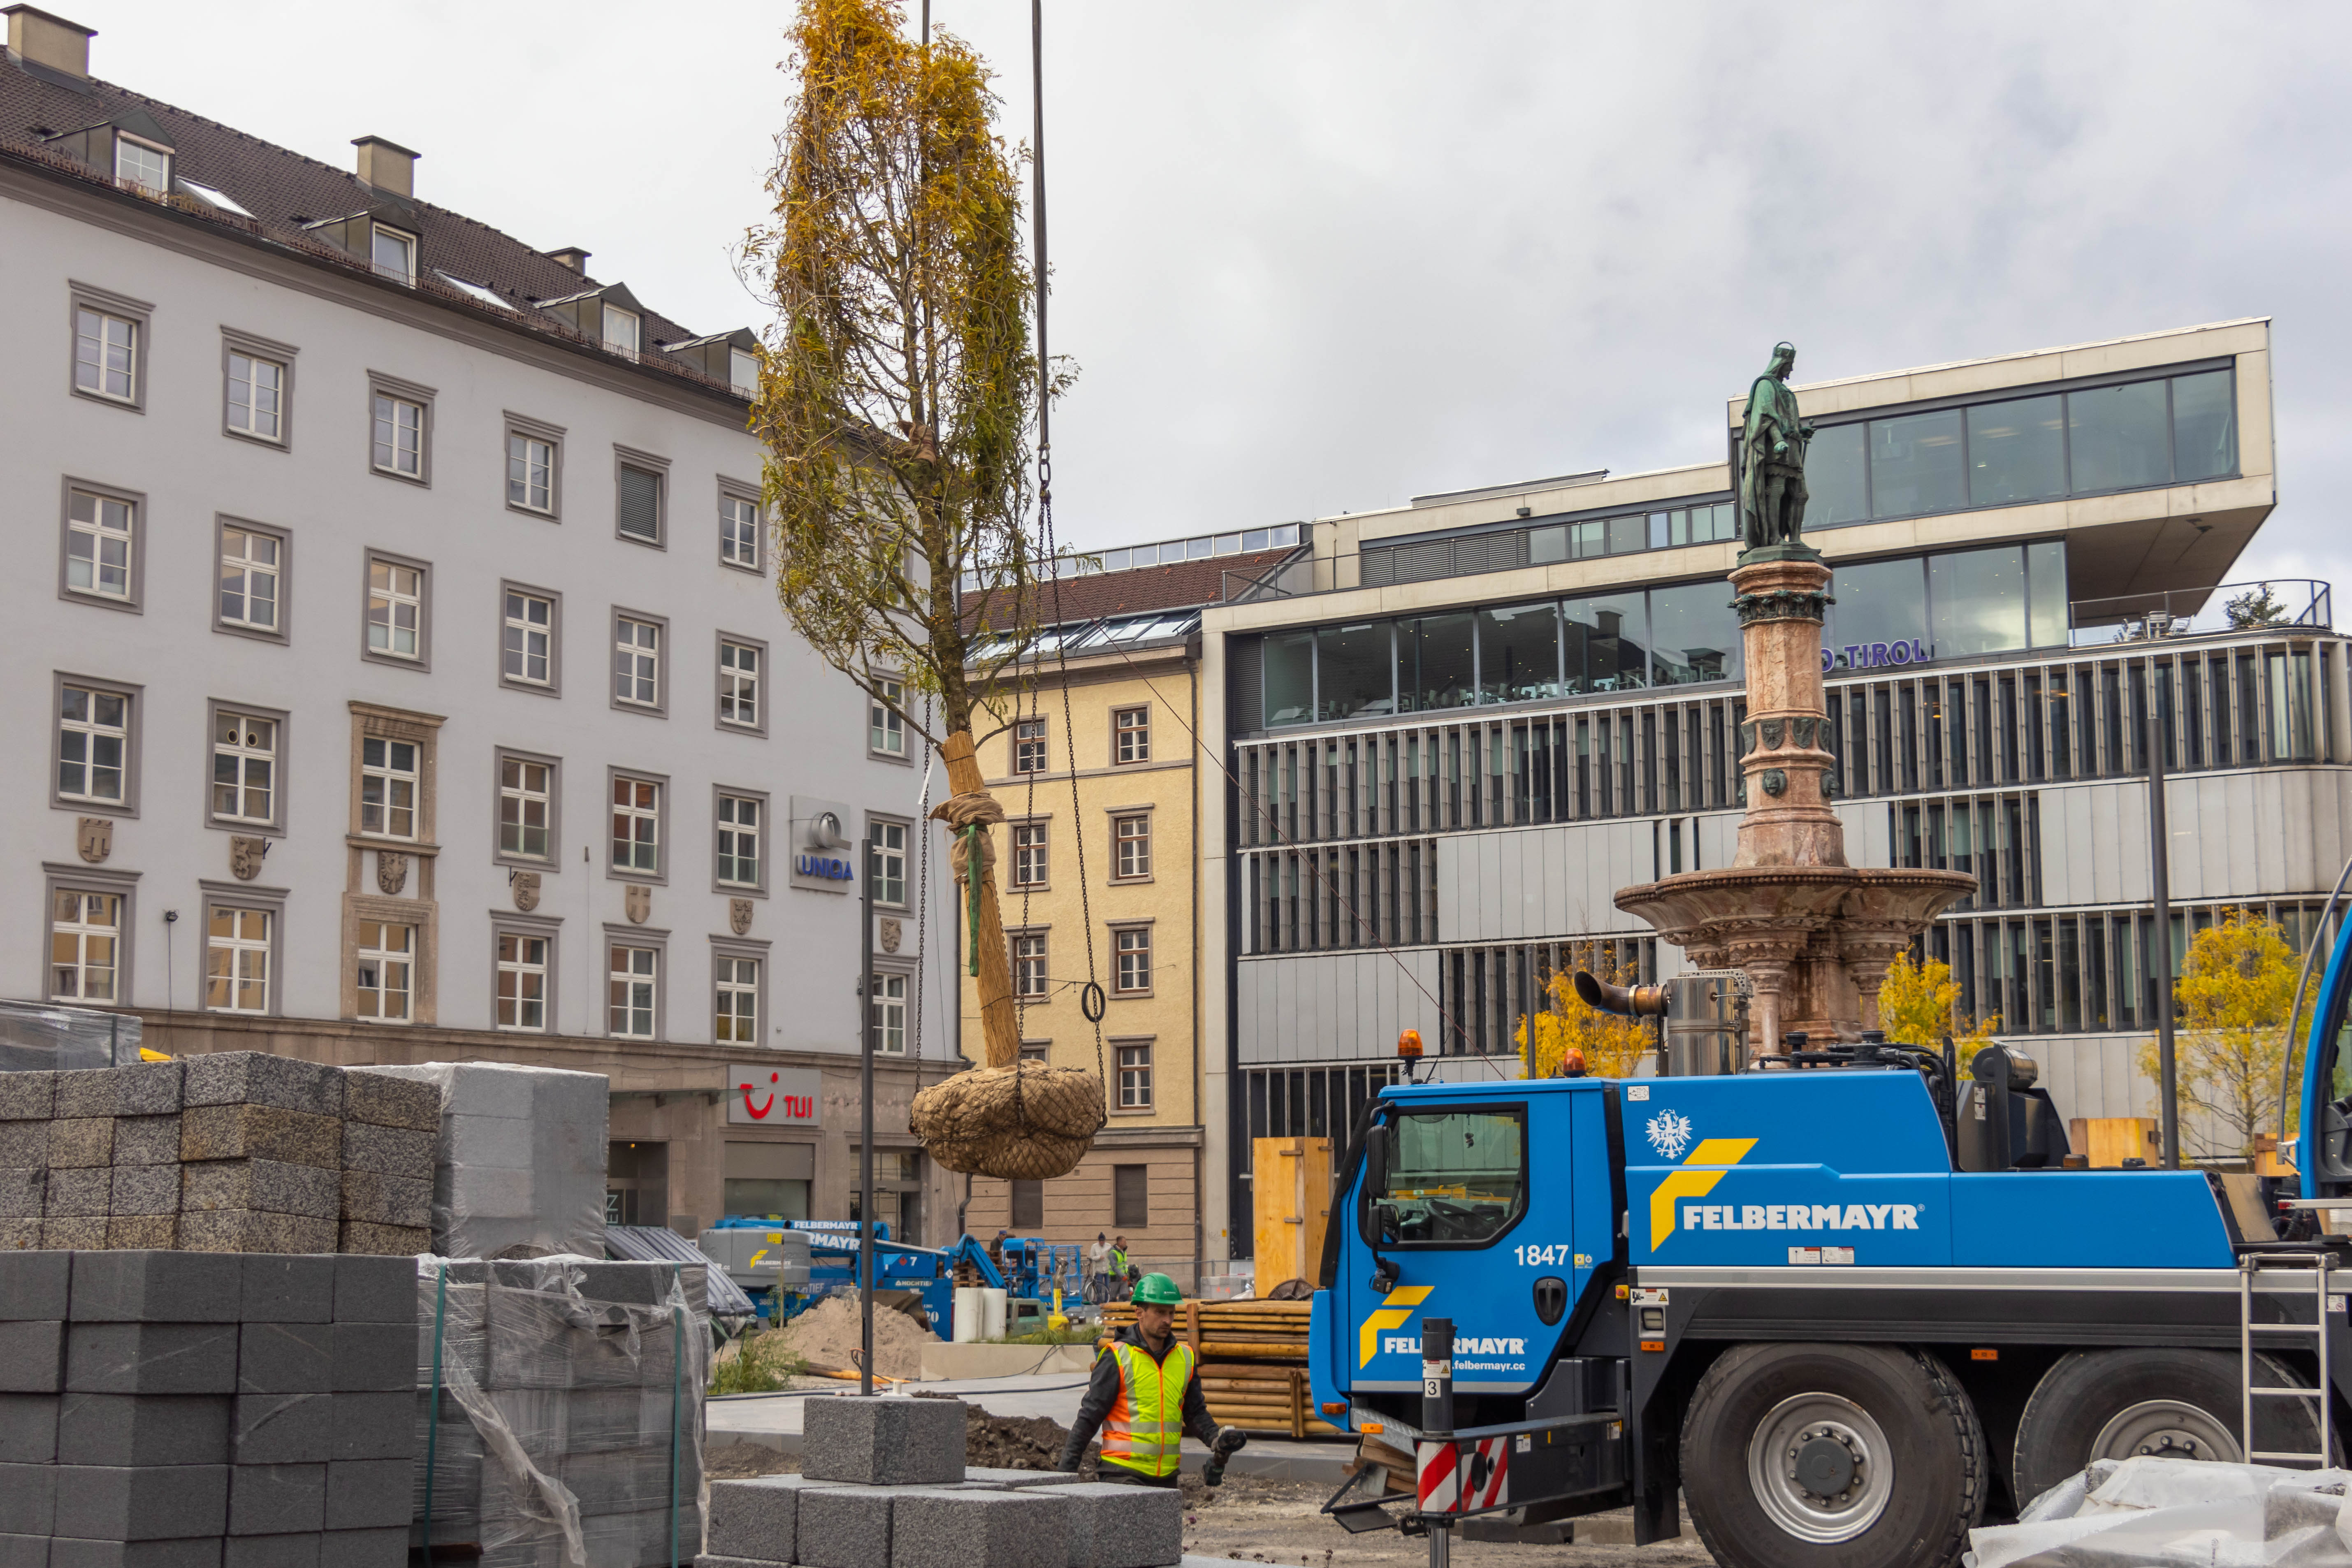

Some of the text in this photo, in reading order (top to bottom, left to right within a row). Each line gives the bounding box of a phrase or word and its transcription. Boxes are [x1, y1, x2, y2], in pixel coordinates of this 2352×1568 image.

[1843, 638, 1930, 669] TIROL
[802, 854, 854, 881] UNIQA
[784, 1095, 813, 1118] TUI
[795, 1221, 858, 1229] FELBERMAYR
[910, 1257, 917, 1266] 7
[1514, 1245, 1569, 1266] 1847
[1452, 1360, 1525, 1372] .felbermayr.cc
[1428, 1381, 1437, 1395] 3
